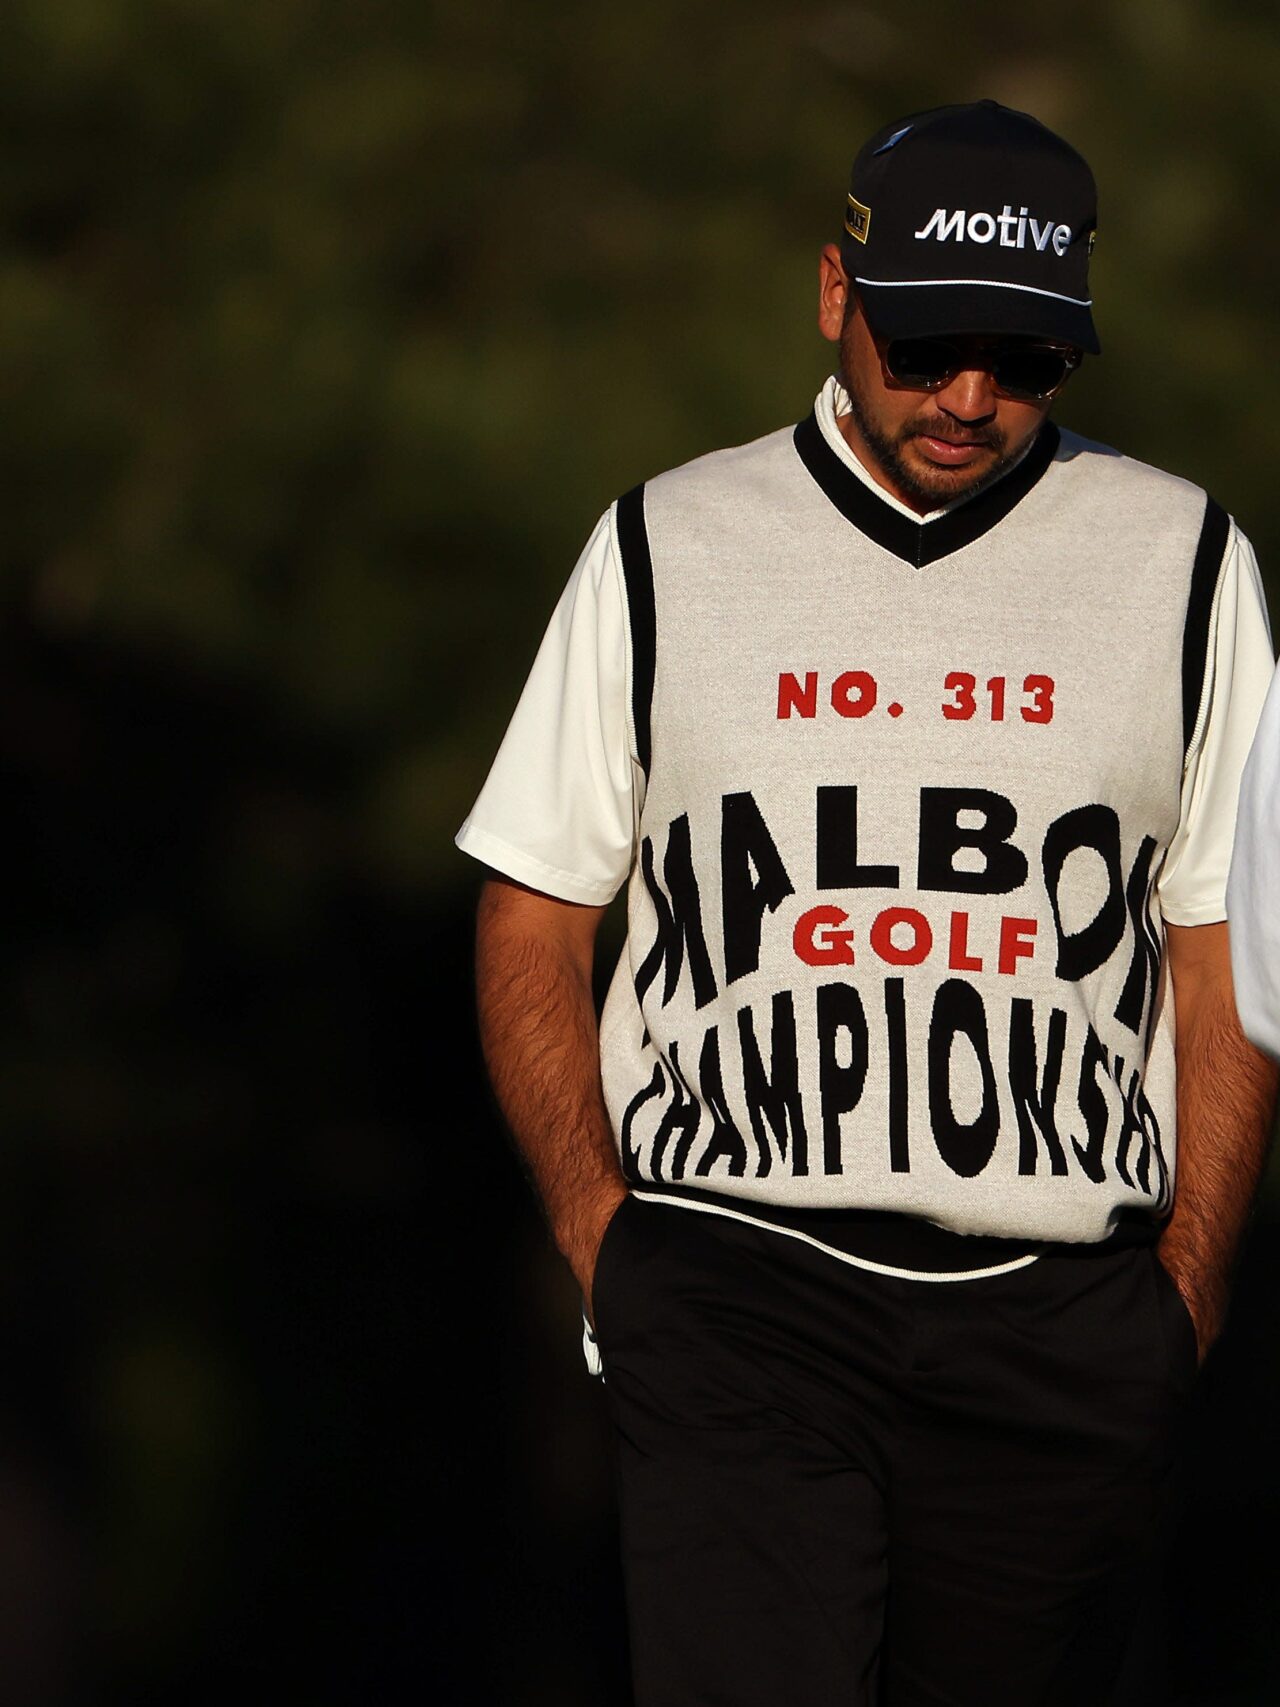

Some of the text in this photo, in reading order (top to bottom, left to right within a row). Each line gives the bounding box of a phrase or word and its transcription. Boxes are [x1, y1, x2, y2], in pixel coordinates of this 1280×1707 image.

[914, 204, 1073, 258] Motive
[776, 670, 1056, 725] NO. 313
[792, 904, 1038, 976] GOLF
